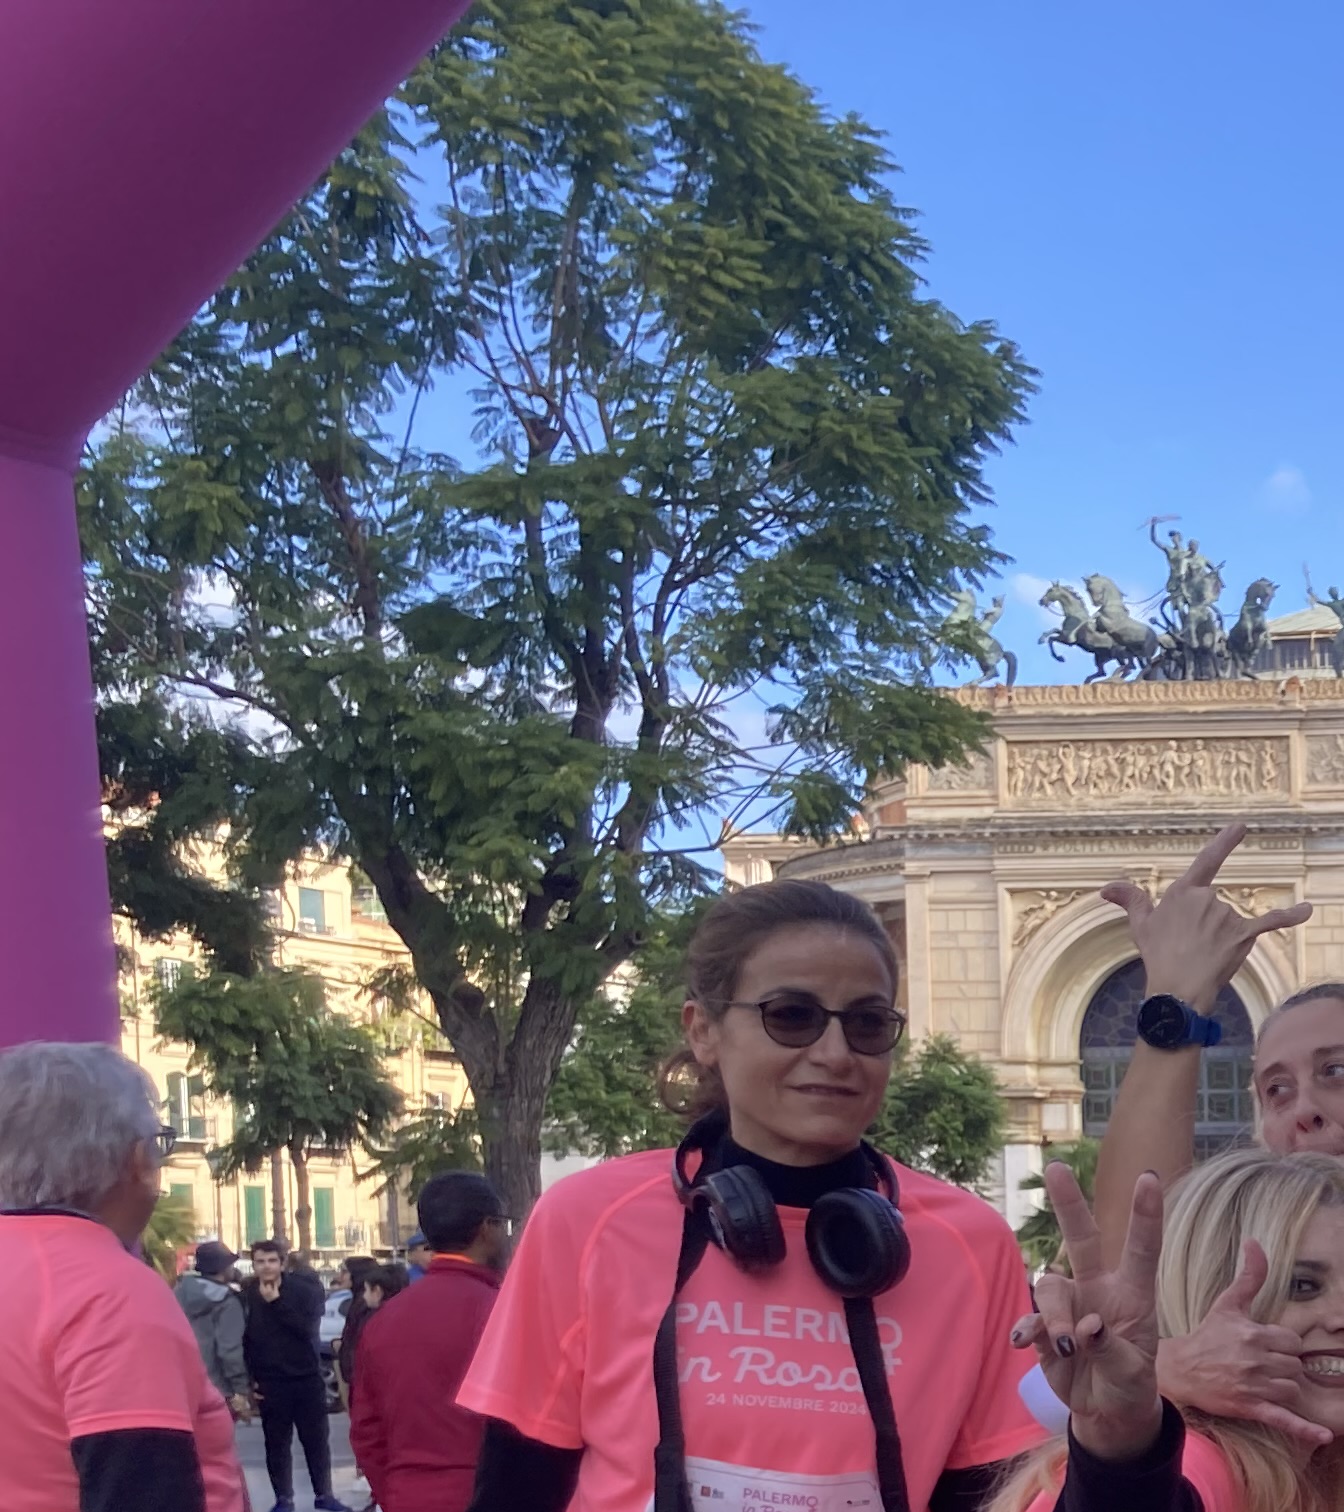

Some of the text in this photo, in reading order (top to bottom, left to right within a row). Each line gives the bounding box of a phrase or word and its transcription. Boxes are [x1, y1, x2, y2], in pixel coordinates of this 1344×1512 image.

[706, 1393, 867, 1415] 24 NOVEMBRE 2024
[742, 1487, 820, 1512] PALERMO
